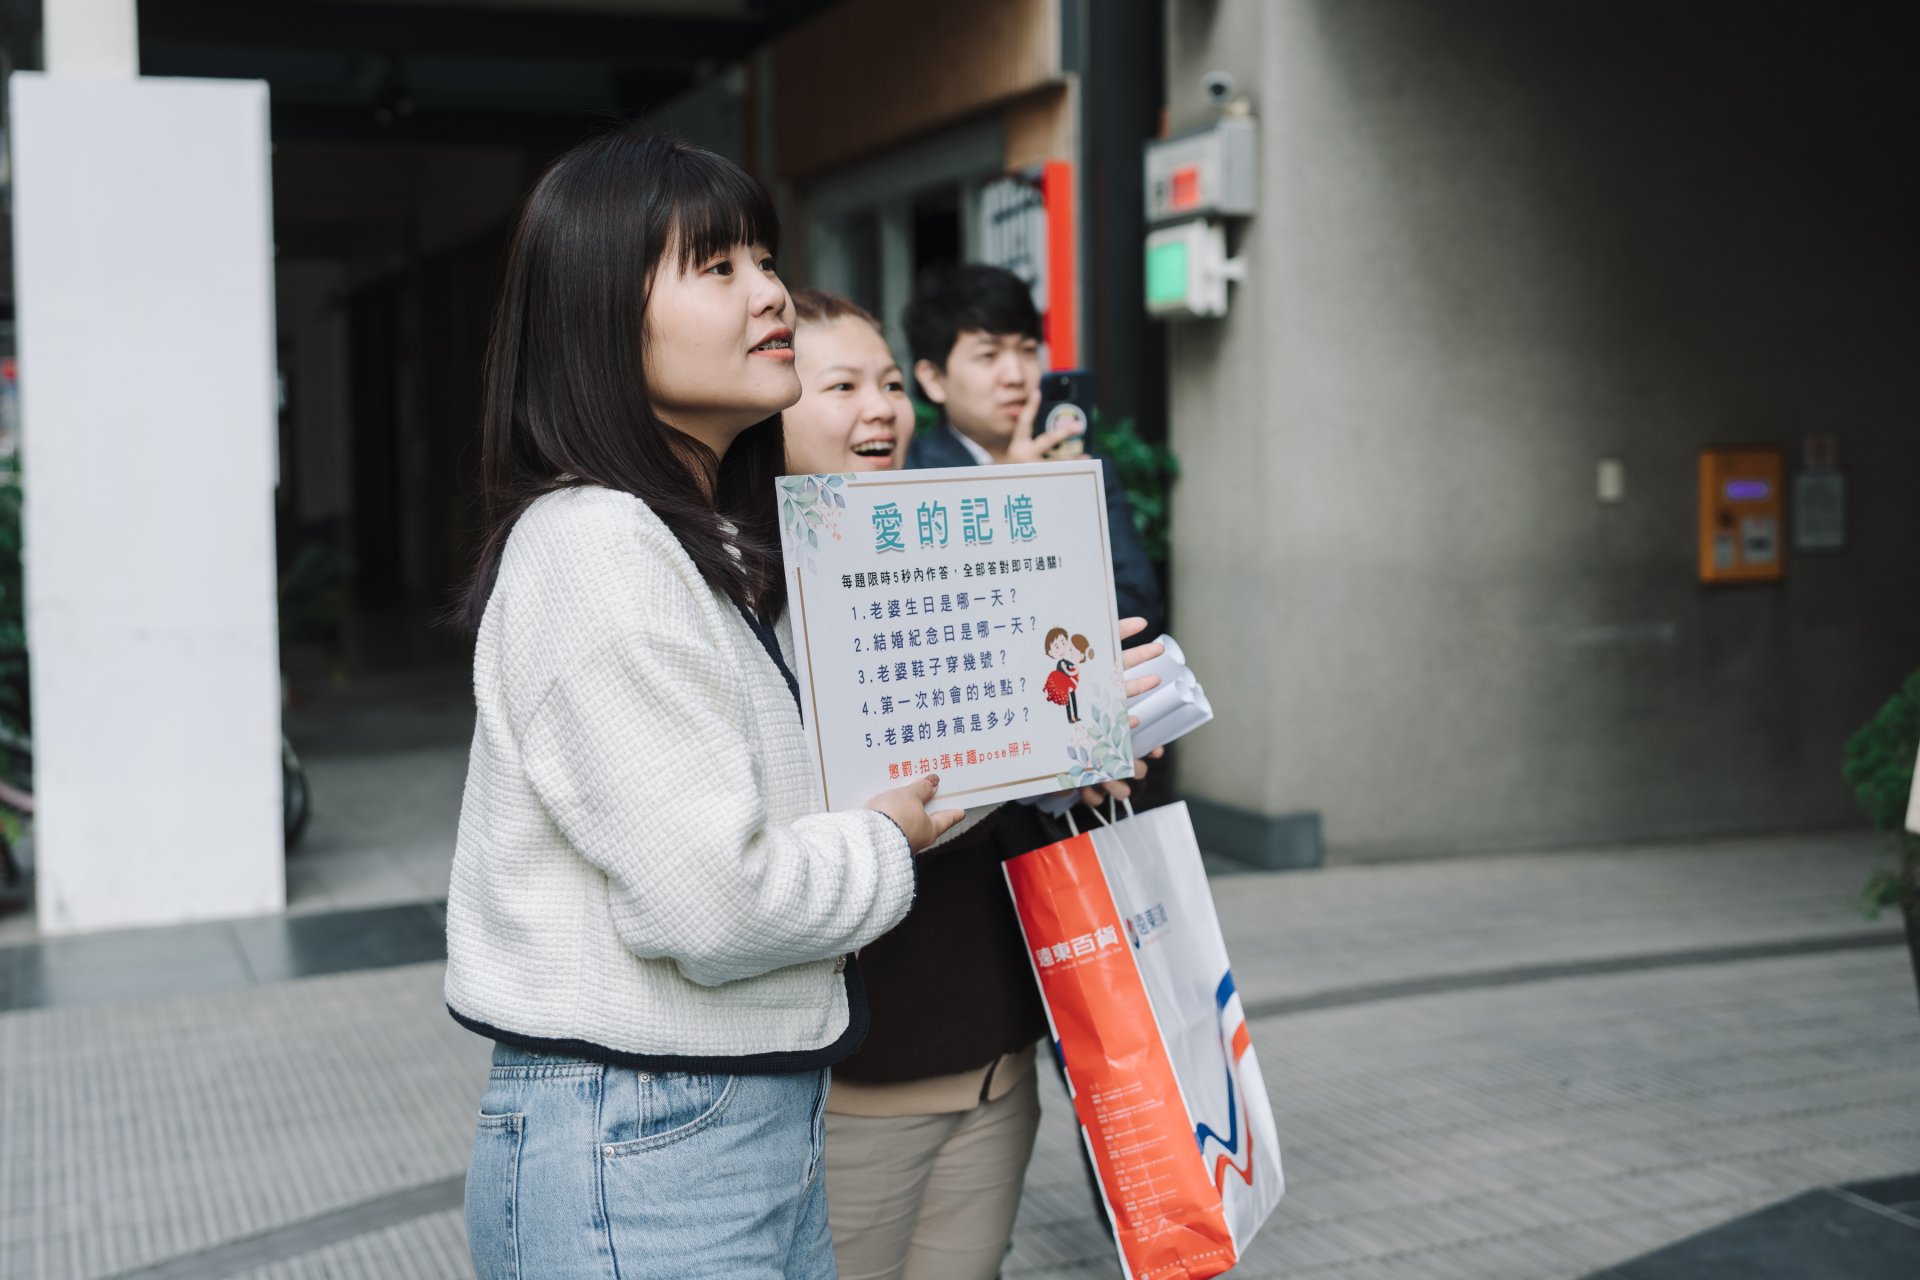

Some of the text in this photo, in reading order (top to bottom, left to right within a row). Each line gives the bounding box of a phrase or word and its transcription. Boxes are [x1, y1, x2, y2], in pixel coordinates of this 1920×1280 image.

[871, 494, 1037, 552] 愛的記憶
[851, 588, 1017, 620] 1.老婆生日是哪一天？
[854, 616, 1036, 653] 2.結婚紀念日是哪一天？
[858, 650, 1006, 684] 3.老婆鞋子穿幾號？
[862, 677, 1026, 716] 4.第一次約會的地點？
[865, 707, 1029, 748] 5.老婆的身高是多少？
